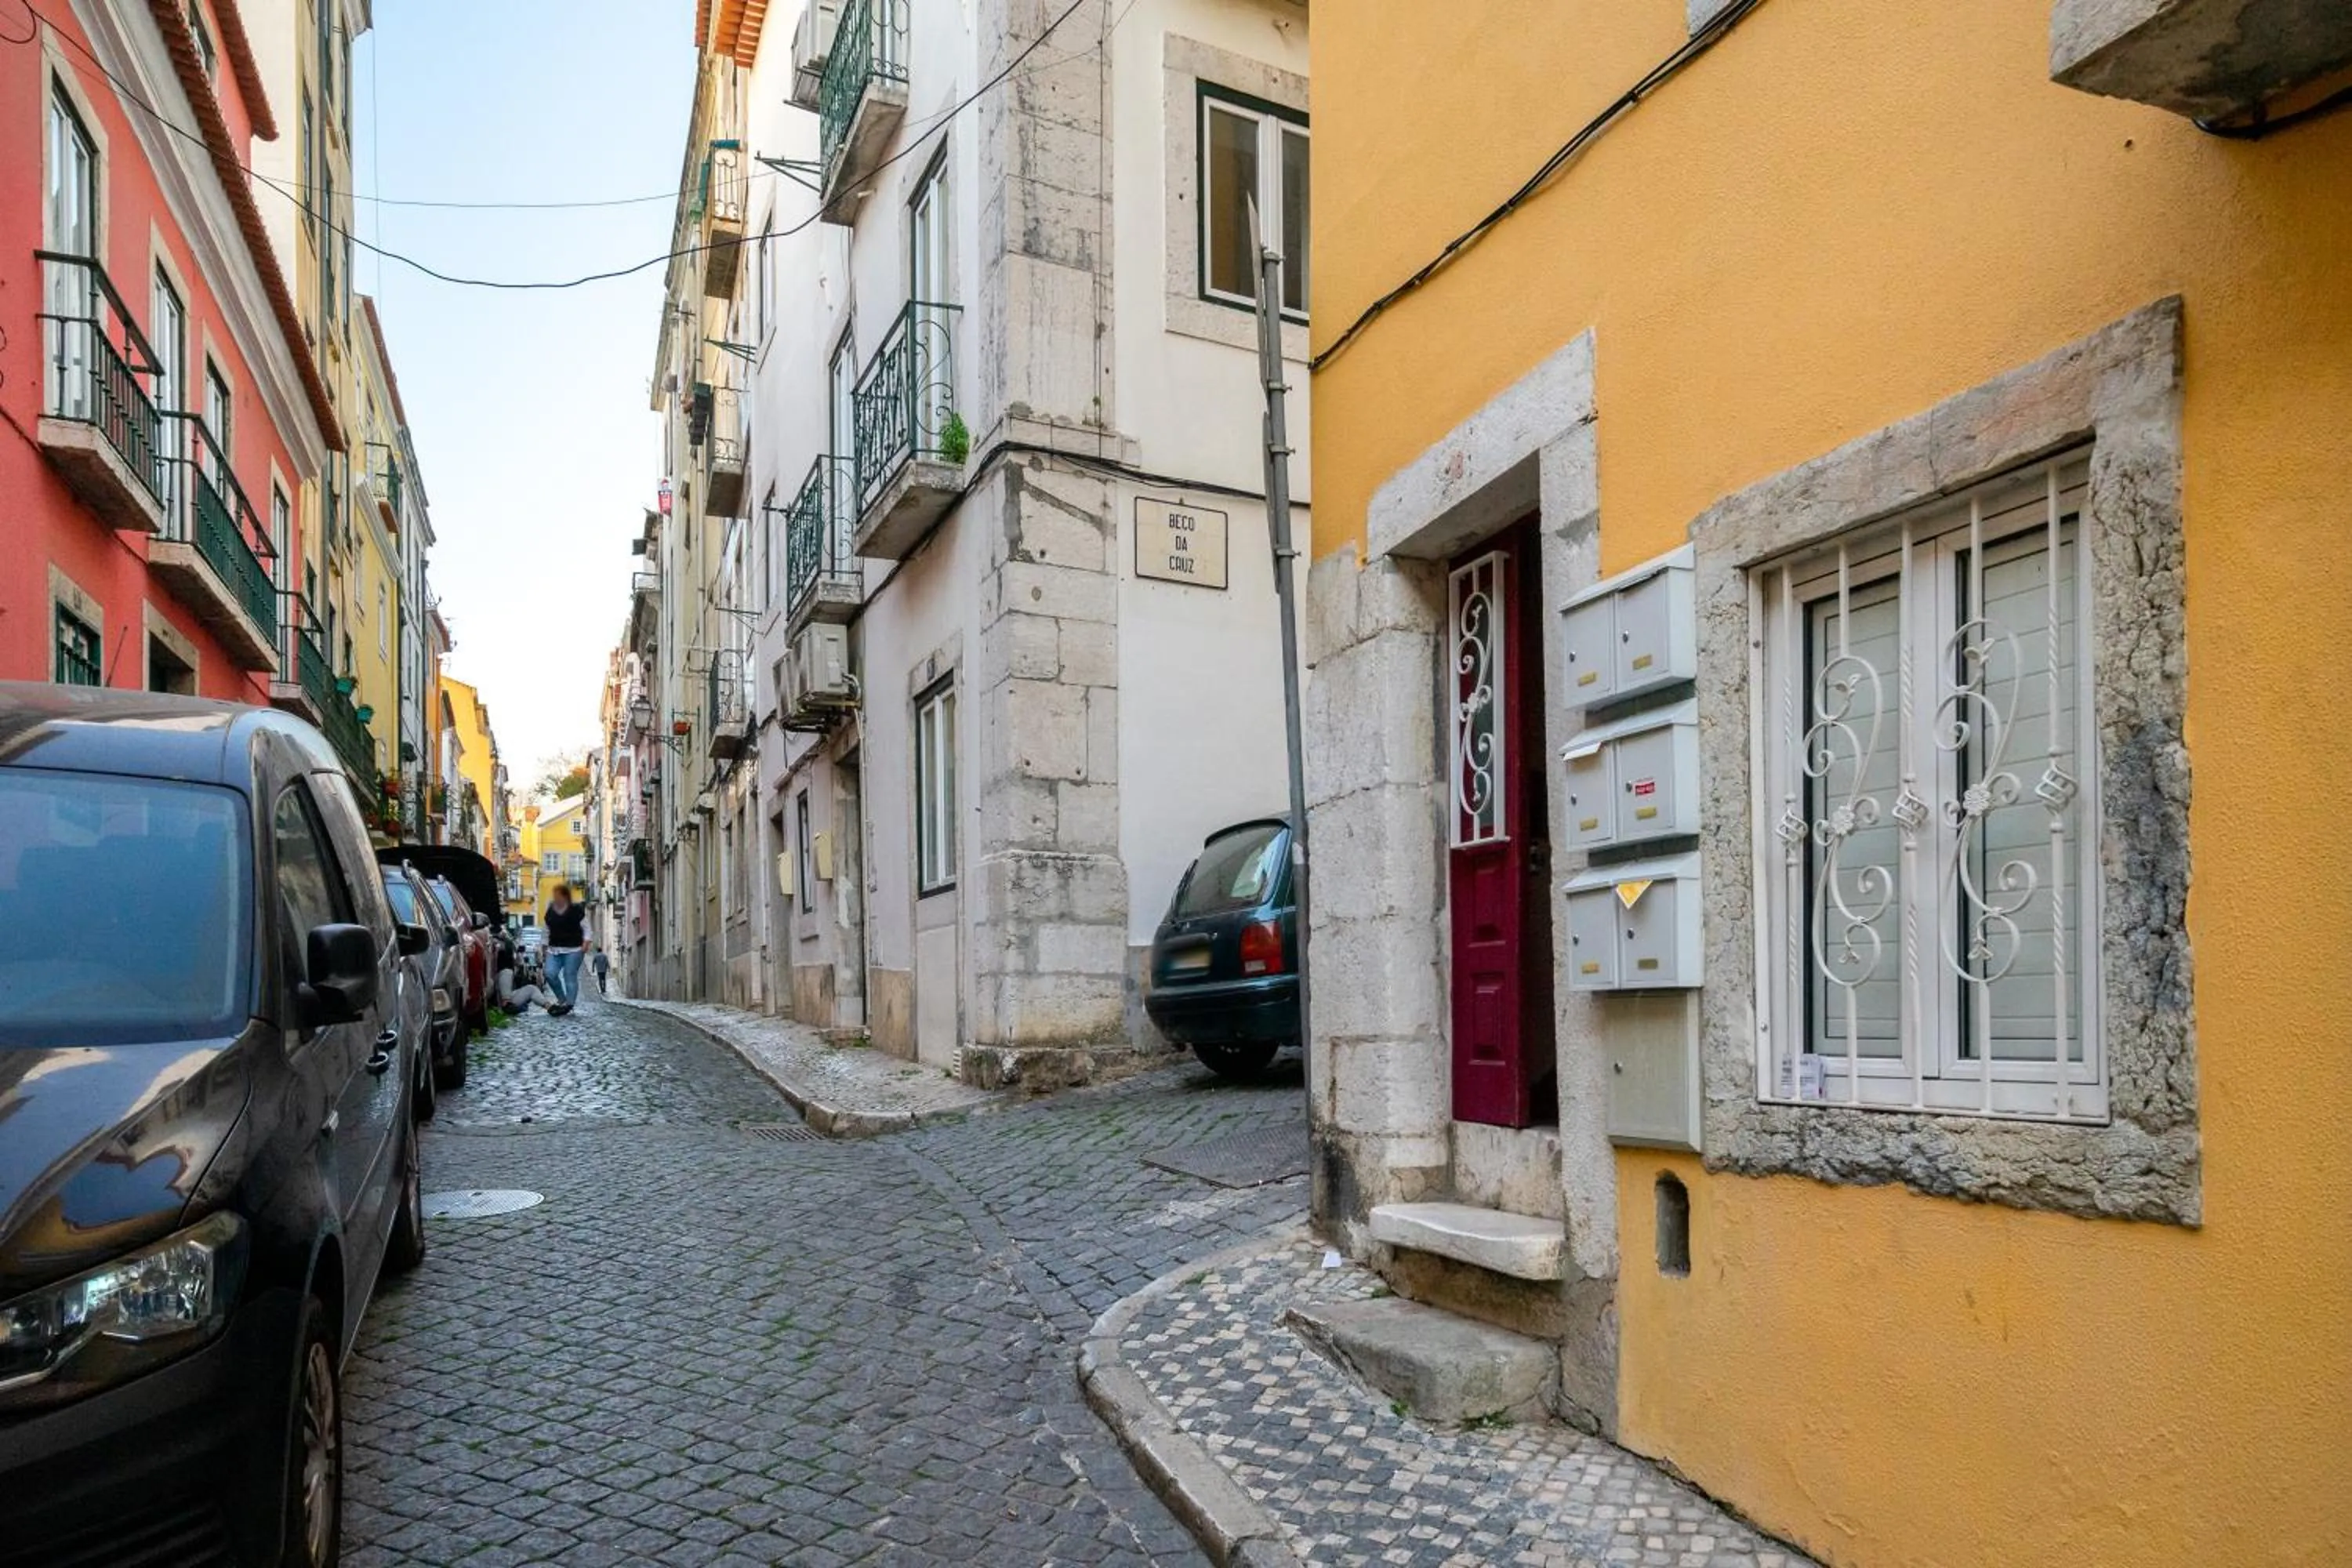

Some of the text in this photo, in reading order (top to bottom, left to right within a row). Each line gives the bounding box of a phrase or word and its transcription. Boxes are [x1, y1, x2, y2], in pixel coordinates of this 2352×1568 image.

[1169, 514, 1195, 532] BECO
[1175, 535, 1188, 551] DA
[1169, 555, 1194, 574] CRUZ
